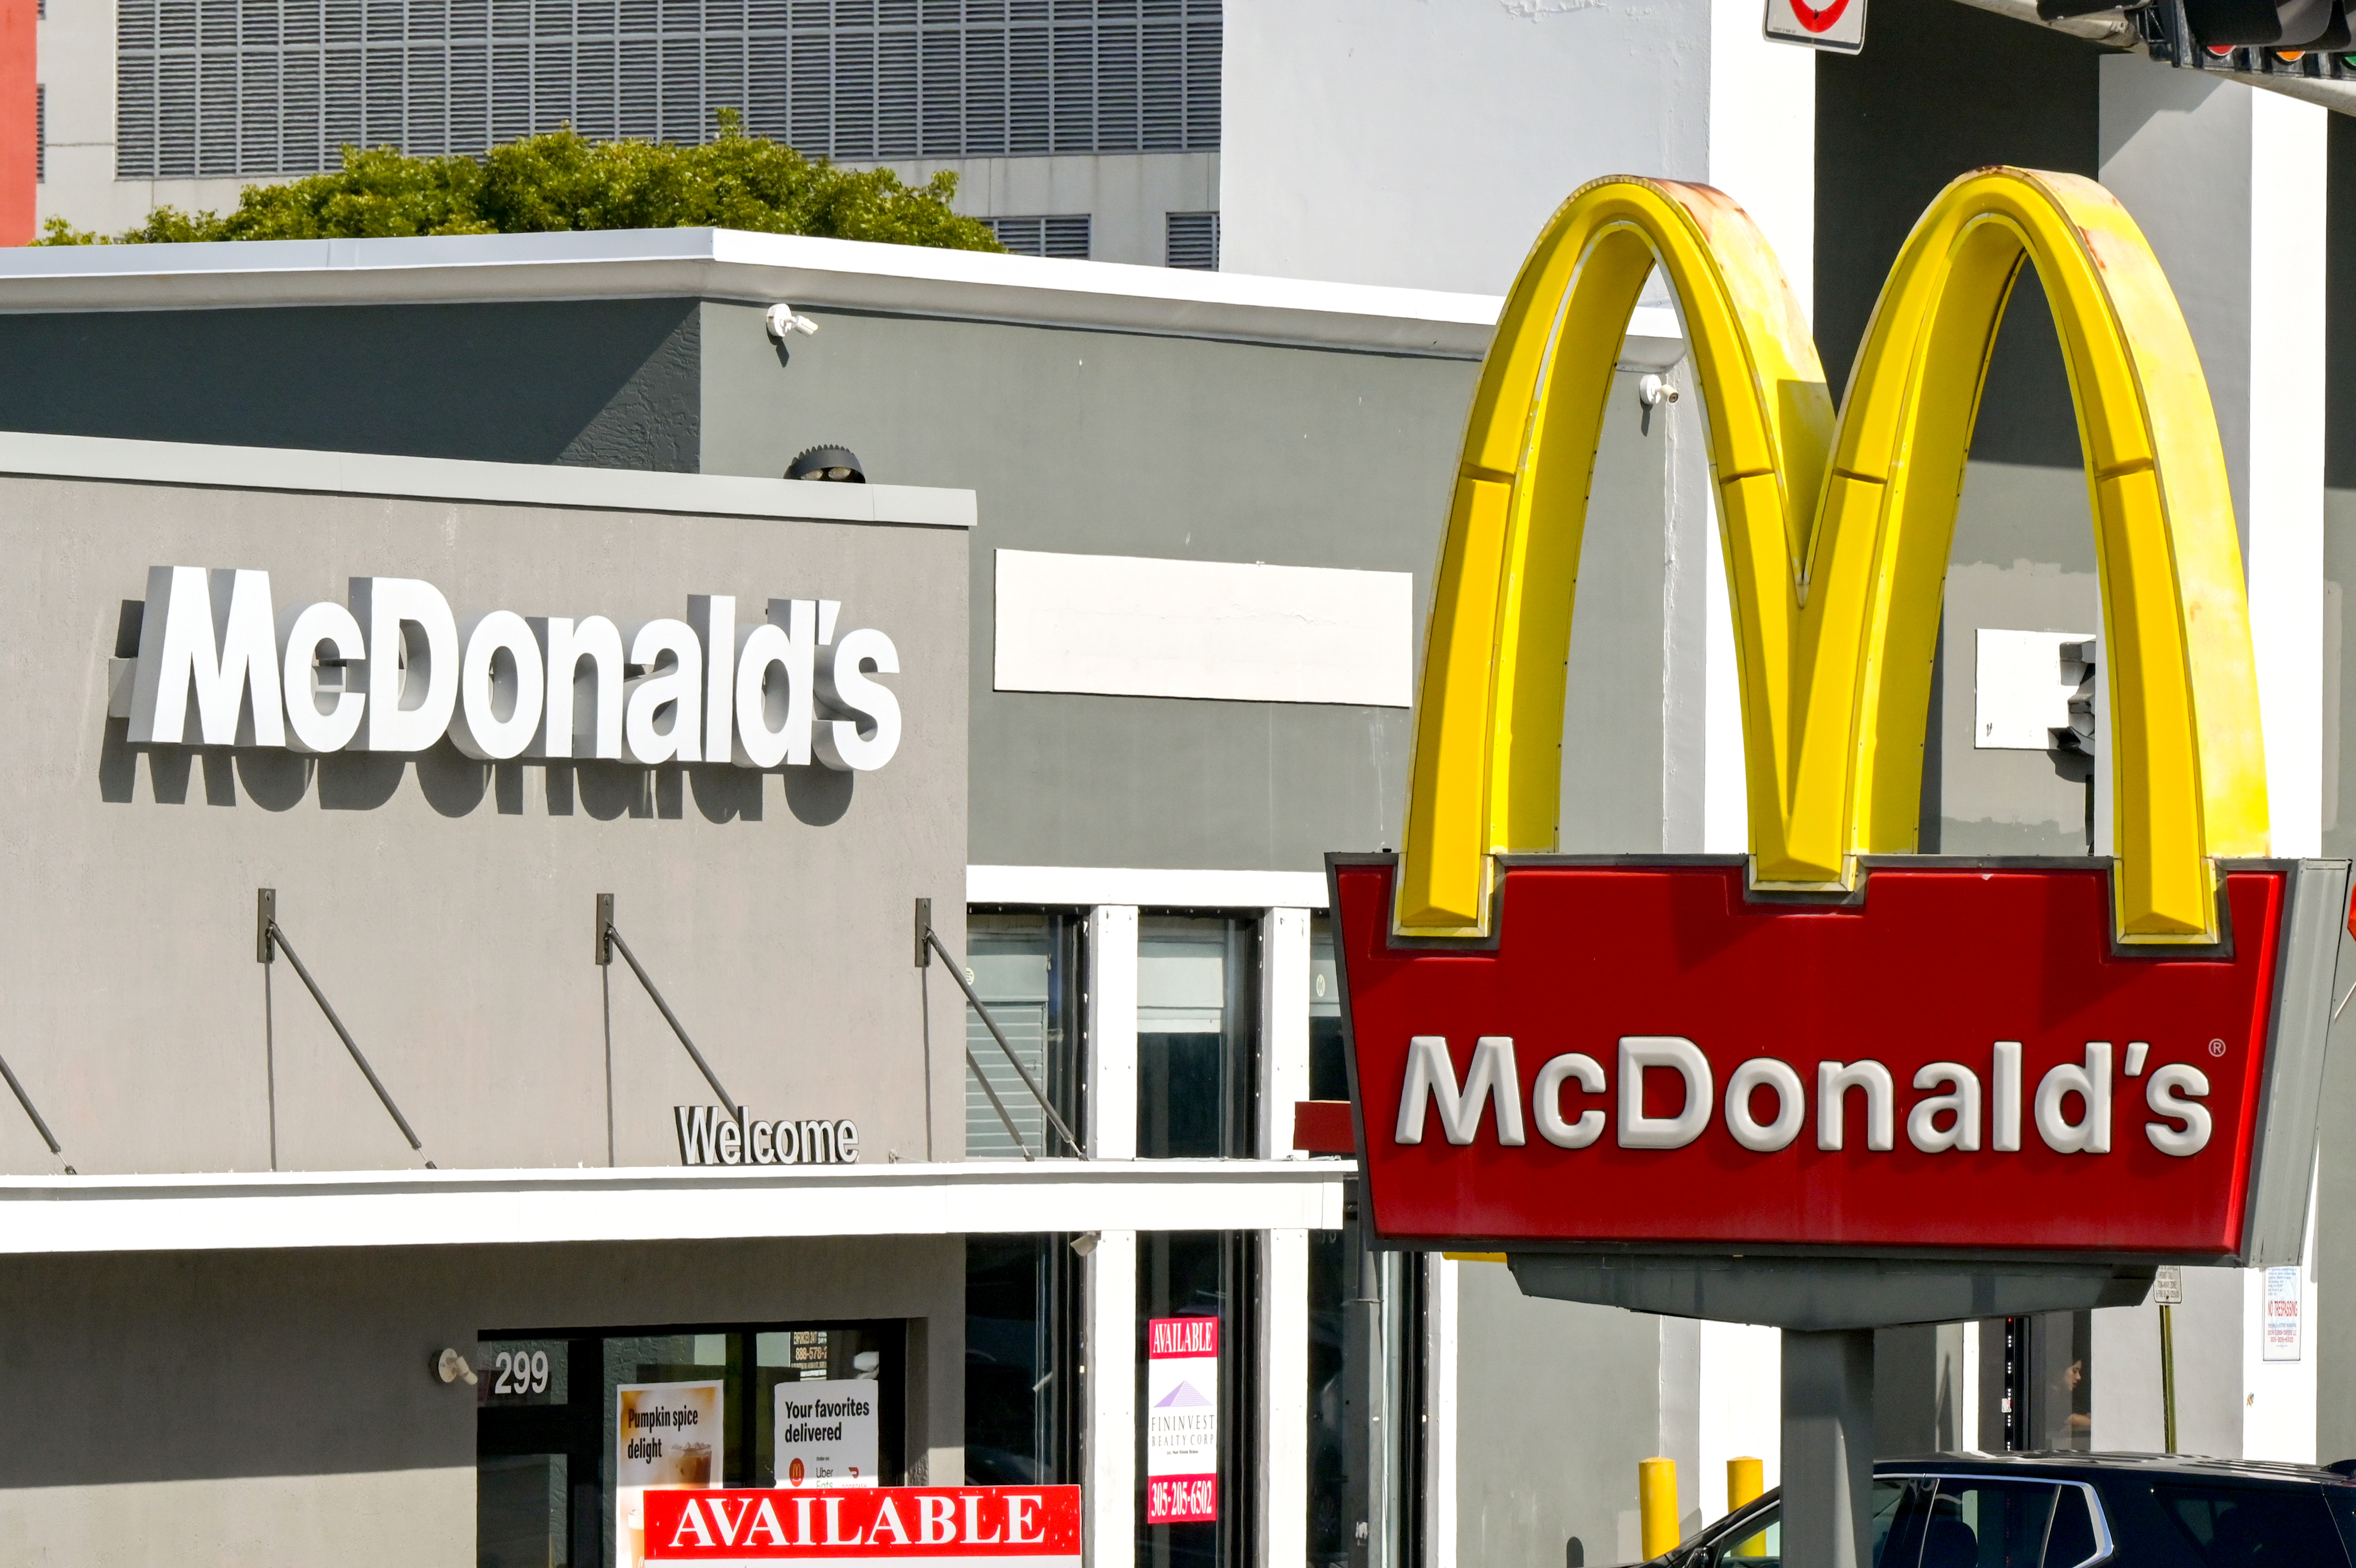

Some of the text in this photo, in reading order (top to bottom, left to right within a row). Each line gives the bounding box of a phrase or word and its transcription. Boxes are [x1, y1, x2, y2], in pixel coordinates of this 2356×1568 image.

[150, 565, 902, 772] McDonald's
[1395, 1034, 2213, 1157] McDonald's
[674, 1105, 859, 1165] Welcome
[2268, 1300, 2298, 1317] NO TRESPASSING
[1153, 1322, 1212, 1353] AVAILABLE
[495, 1350, 548, 1394] 299
[628, 1405, 698, 1433] Pumpkin spice
[785, 1397, 870, 1419] Your favorites
[785, 1422, 842, 1442] delivered
[1151, 1415, 1215, 1431] FININVEST
[628, 1438, 662, 1464] delight
[1152, 1434, 1213, 1447] REALTY CORP
[816, 1467, 833, 1478] Uber
[668, 1494, 1045, 1547] AVAILABLE
